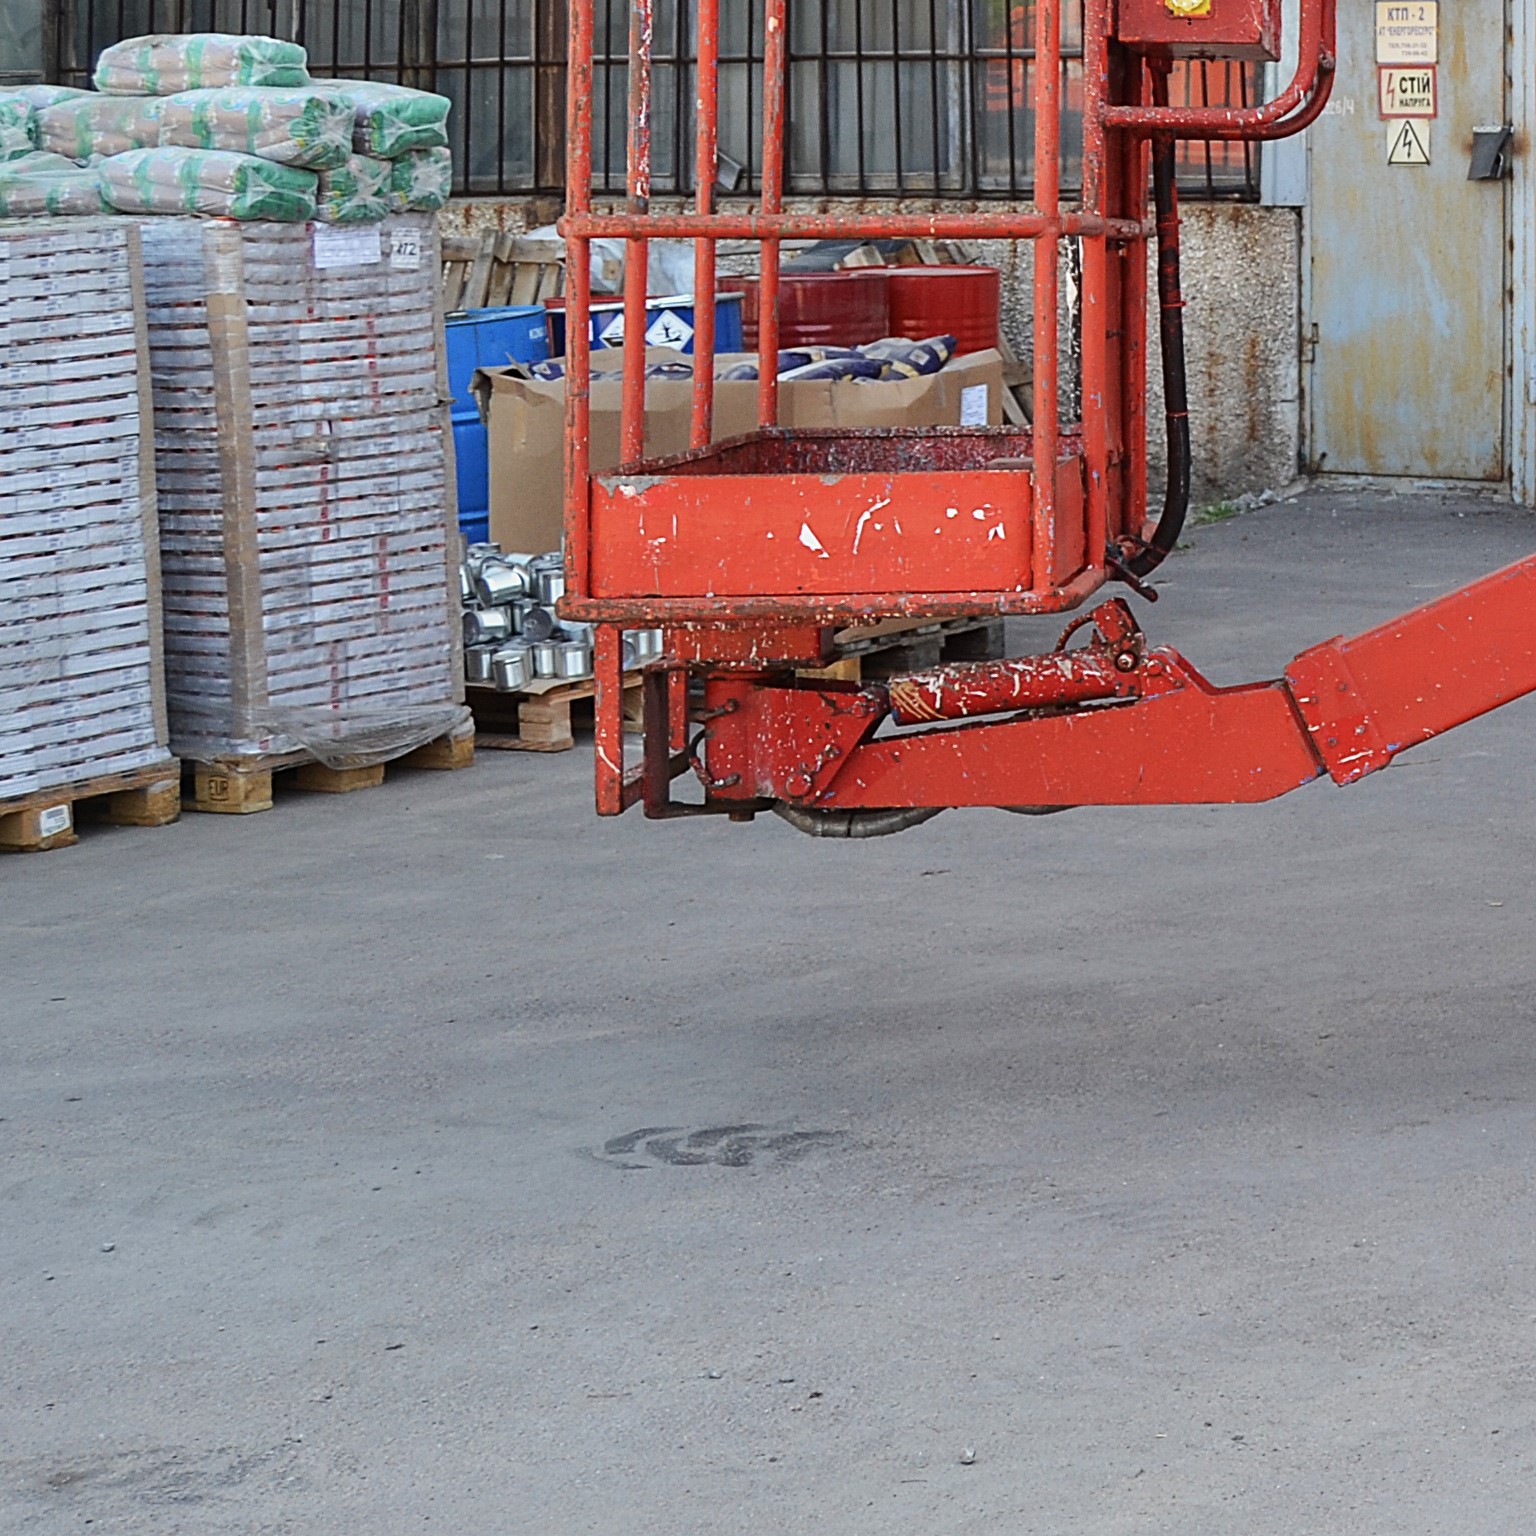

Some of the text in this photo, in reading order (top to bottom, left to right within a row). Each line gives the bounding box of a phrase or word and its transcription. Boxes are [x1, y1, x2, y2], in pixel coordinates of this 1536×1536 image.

[1387, 7, 1409, 21] КТП
[1418, 6, 1425, 21] 2
[1399, 73, 1431, 94] СТІЙ
[1399, 98, 1431, 107] НАПРУГА
